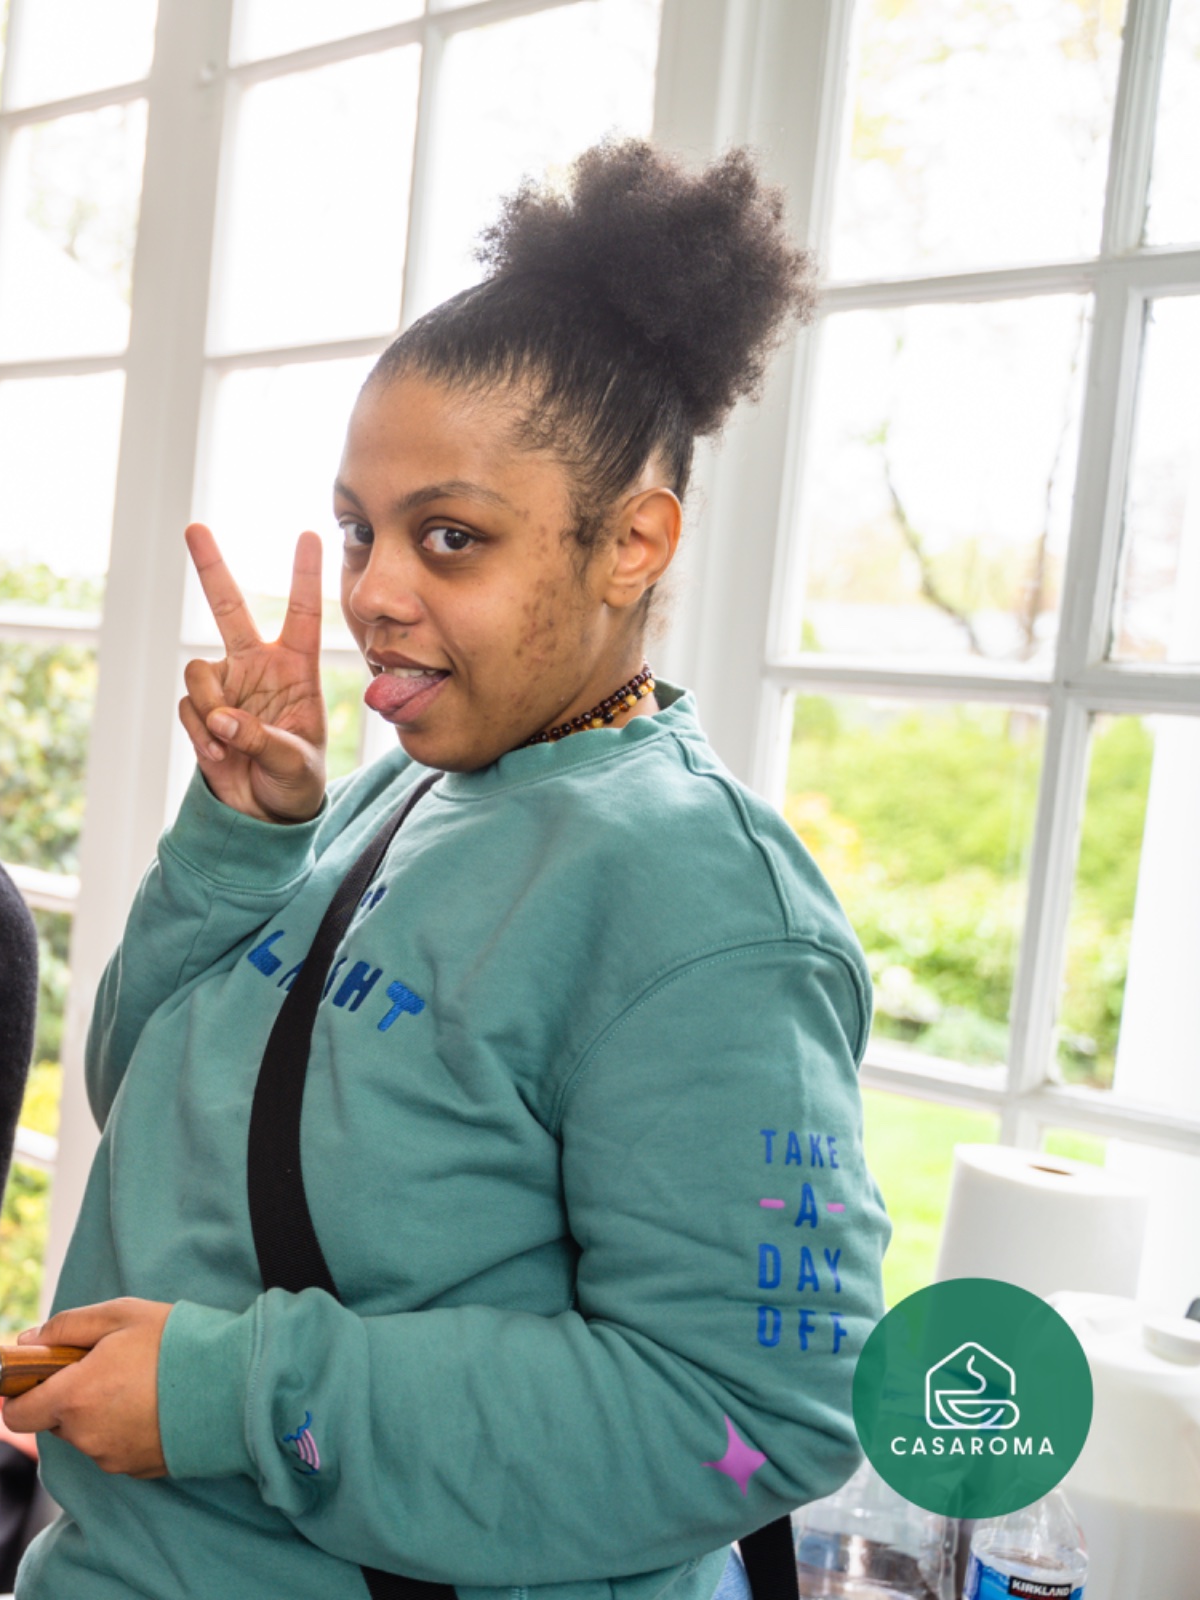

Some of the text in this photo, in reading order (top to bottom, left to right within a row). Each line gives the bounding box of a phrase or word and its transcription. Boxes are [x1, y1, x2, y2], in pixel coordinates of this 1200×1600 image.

[759, 1129, 839, 1169] TAKE
[757, 1243, 842, 1293] DAY
[757, 1306, 848, 1354] OFF
[1011, 1579, 1070, 1597] KIRKLAND
